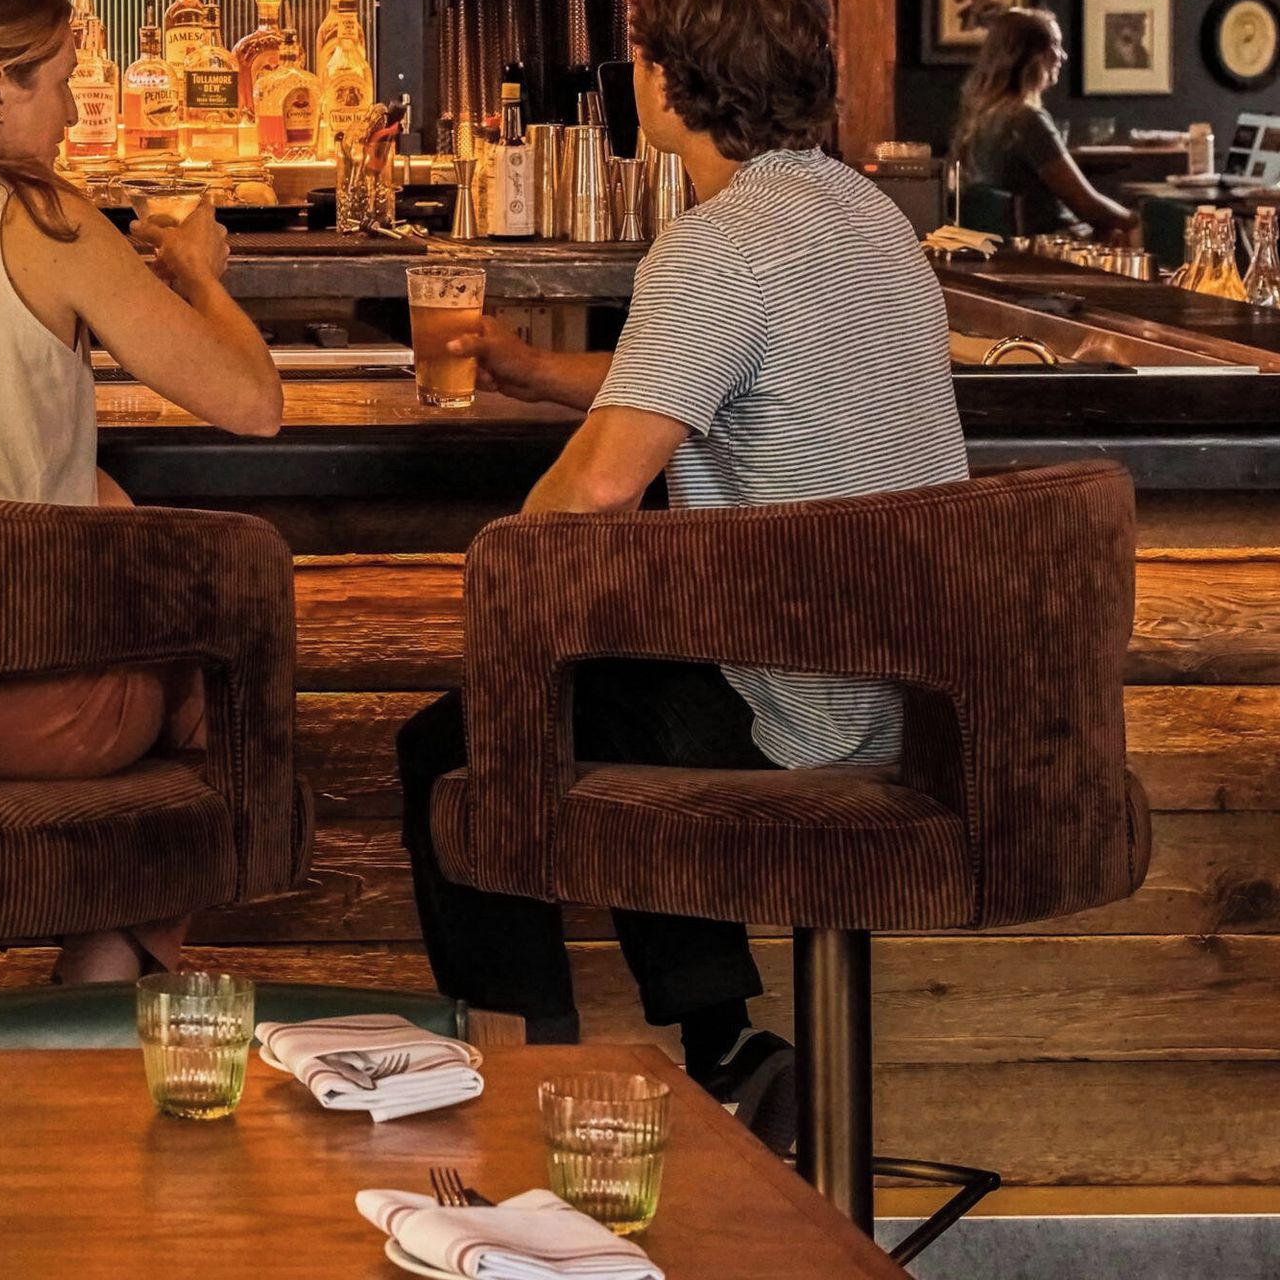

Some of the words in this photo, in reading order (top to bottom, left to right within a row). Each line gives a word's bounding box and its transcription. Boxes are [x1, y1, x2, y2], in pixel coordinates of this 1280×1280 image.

[168, 31, 203, 44] JAMES
[192, 73, 232, 84] TULLAMORE
[203, 84, 220, 93] DEW
[79, 117, 112, 126] HISKEY
